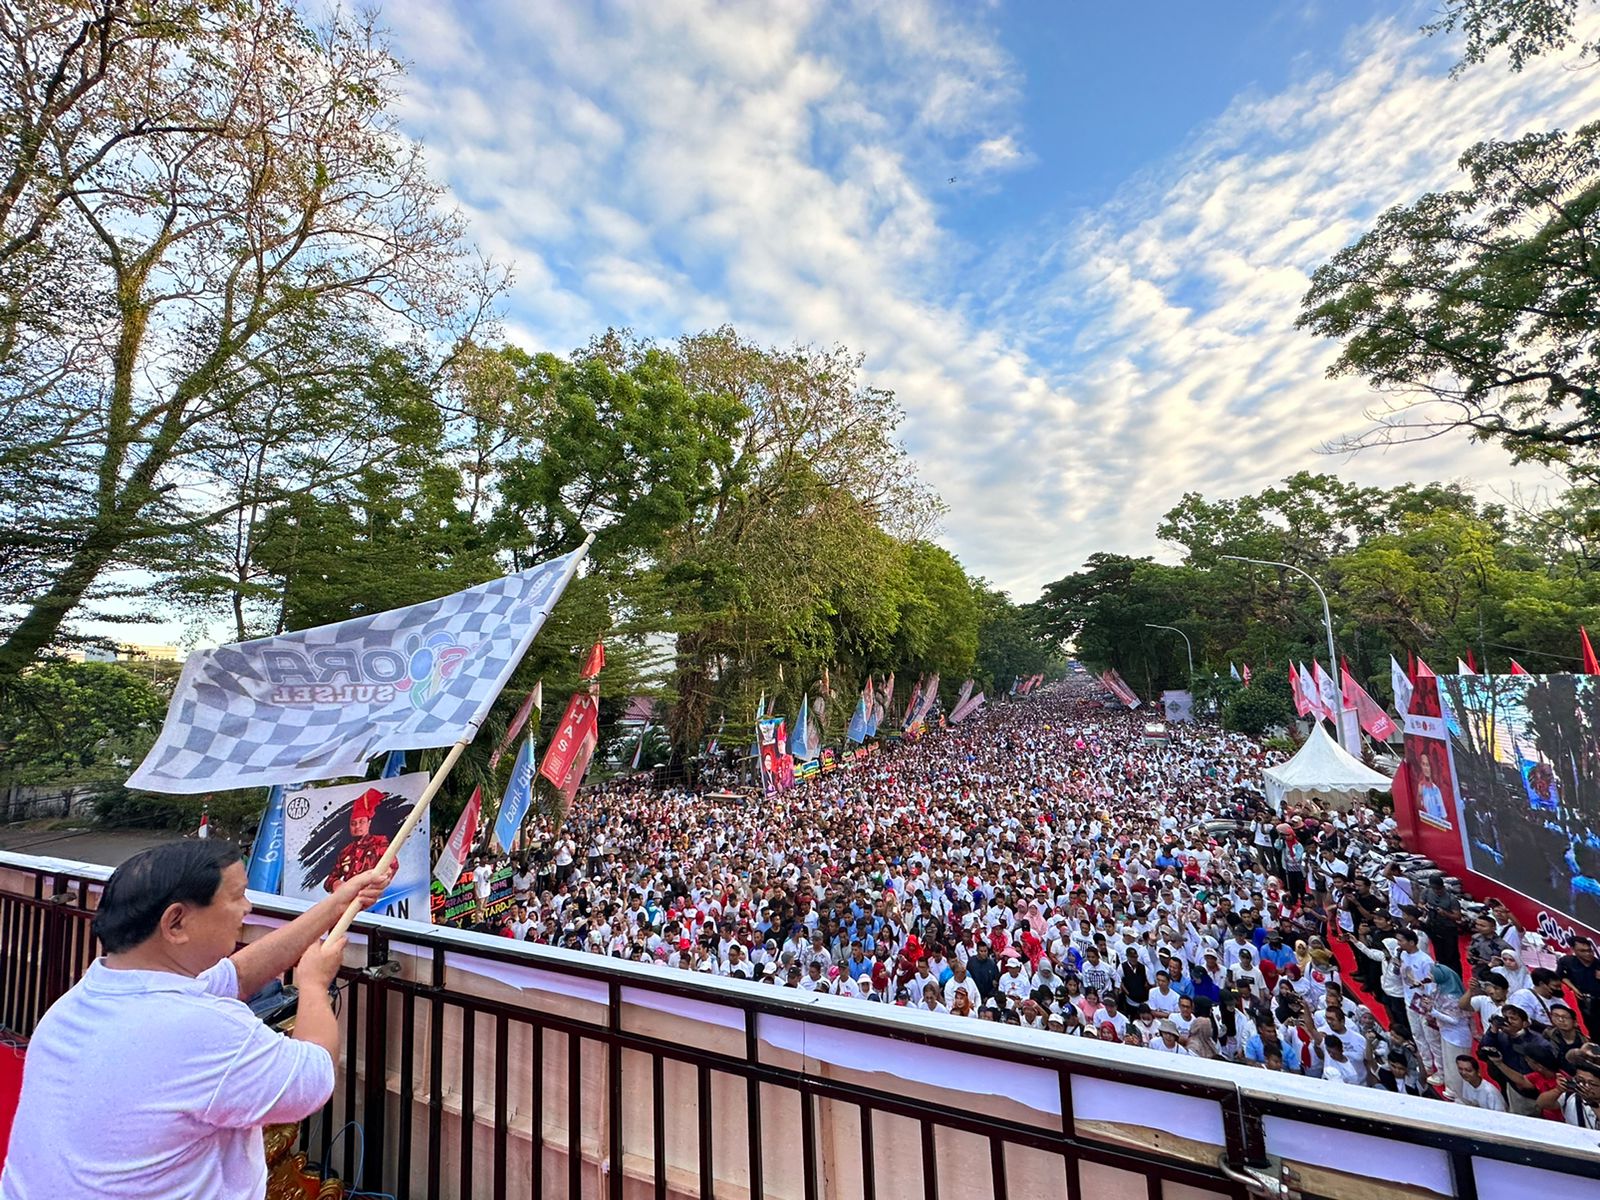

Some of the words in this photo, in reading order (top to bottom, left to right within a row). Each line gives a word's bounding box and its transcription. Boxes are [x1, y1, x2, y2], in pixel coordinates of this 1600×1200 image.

[288, 798, 308, 810] REAL
[504, 788, 524, 824] bank
[288, 807, 308, 819] MAN
